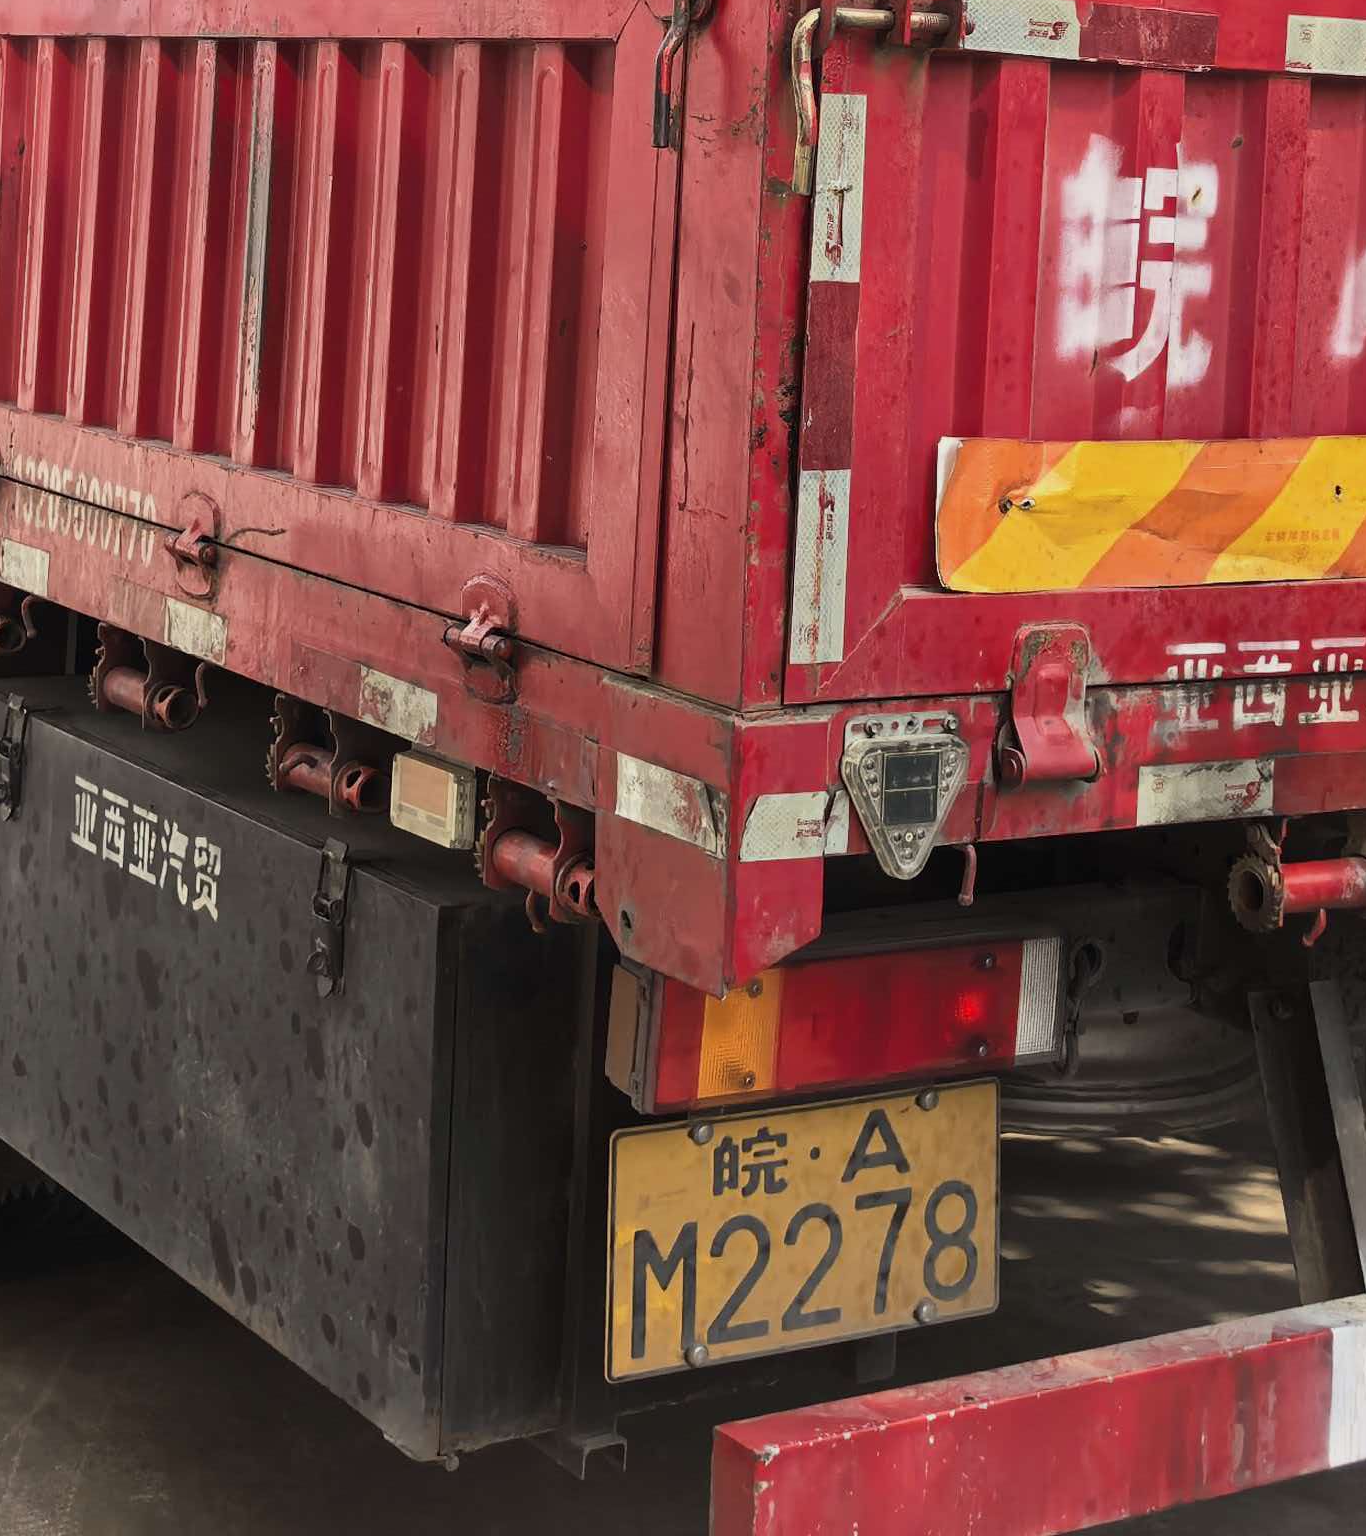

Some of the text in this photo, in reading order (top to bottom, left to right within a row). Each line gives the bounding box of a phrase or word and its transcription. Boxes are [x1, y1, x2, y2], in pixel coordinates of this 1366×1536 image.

[71, 775, 222, 922] 亚西亚汽贸
[631, 1180, 978, 1358] M2278
